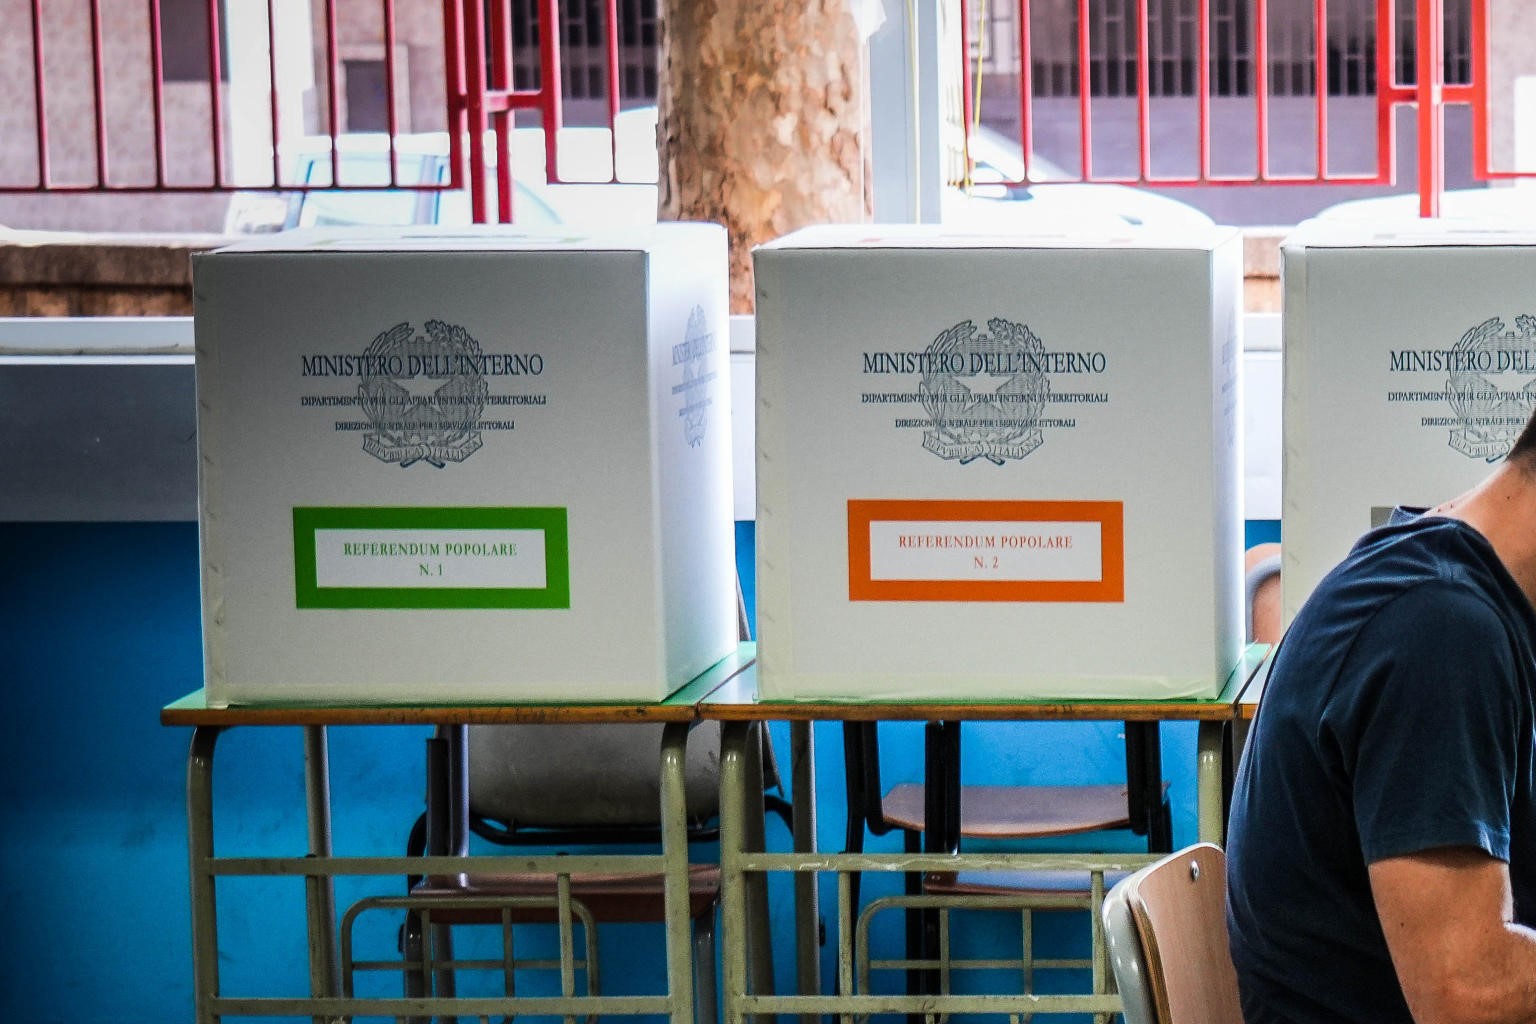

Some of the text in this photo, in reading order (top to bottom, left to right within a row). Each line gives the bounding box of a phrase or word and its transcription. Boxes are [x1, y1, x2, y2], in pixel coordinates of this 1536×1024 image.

[302, 354, 543, 377] MINISTERO DELL'INTERNO
[863, 352, 1106, 374] MINISTERO DELL'INTERNO
[1390, 350, 1491, 373] MINISTERO
[486, 396, 546, 406] TERRITORIALI
[1047, 393, 1108, 403] TERRITORIALI
[899, 536, 1073, 549] REFERENDUM POPOLARE
[344, 543, 517, 556] REFERENDUM POPOLARE
[974, 556, 999, 569] N. 2
[419, 563, 443, 577] N. 1
